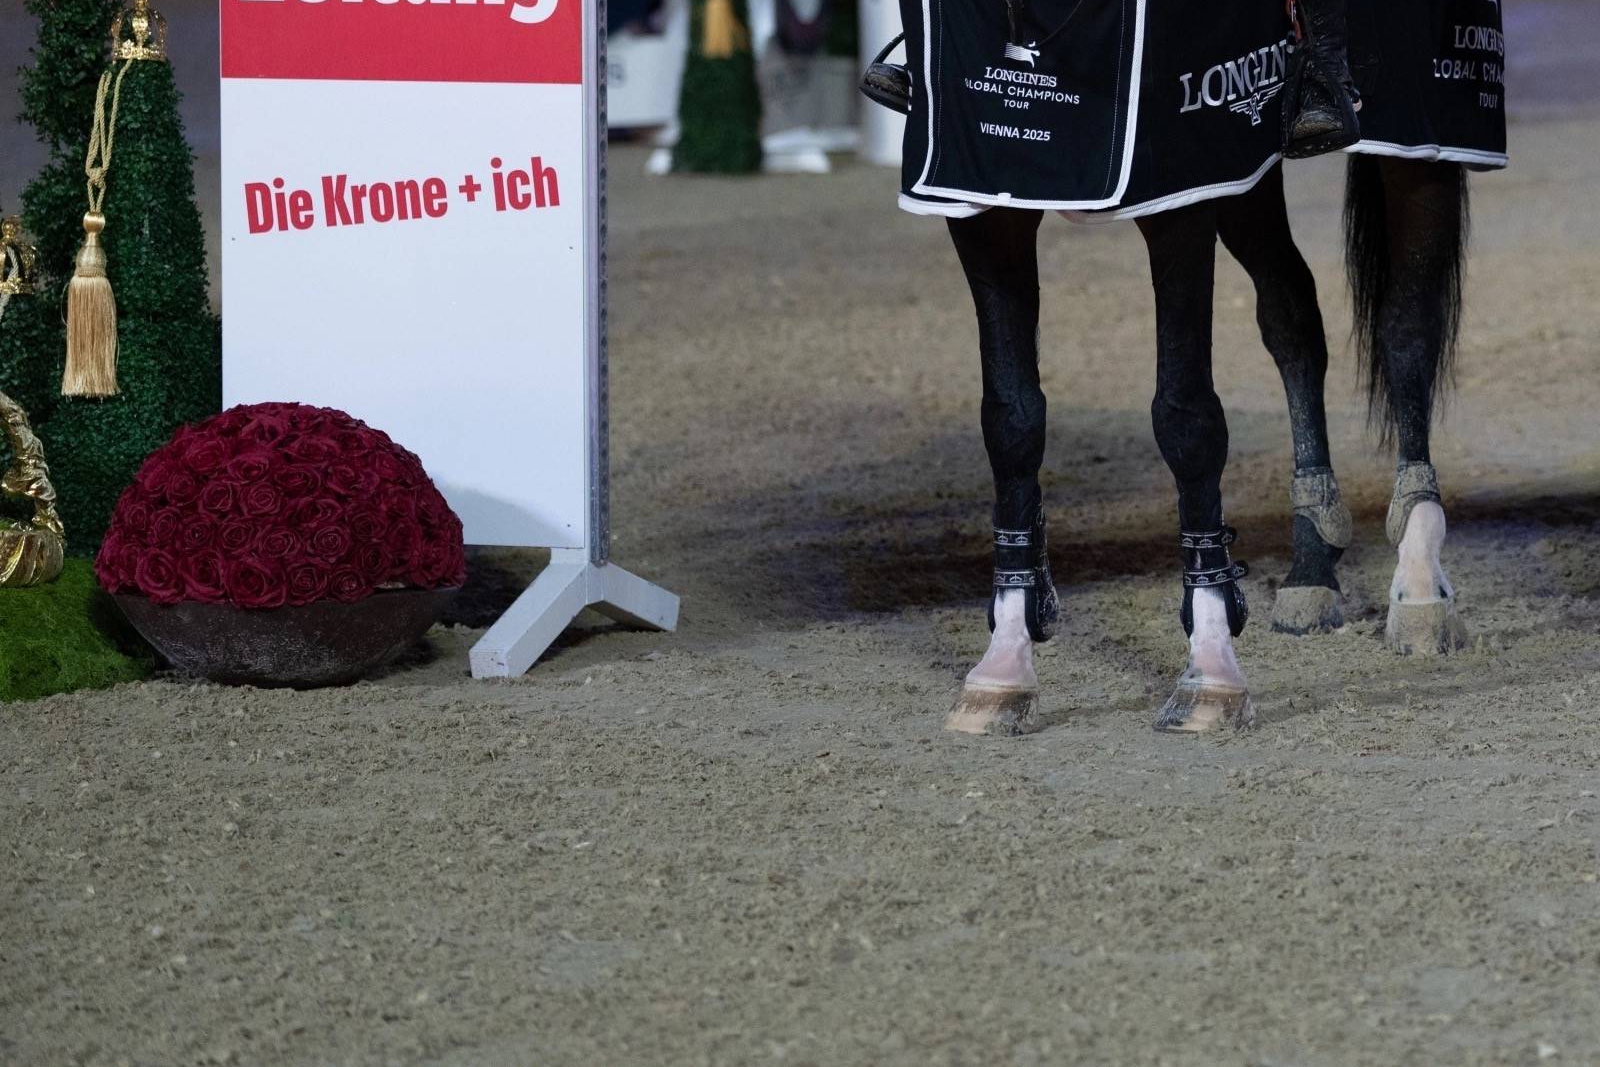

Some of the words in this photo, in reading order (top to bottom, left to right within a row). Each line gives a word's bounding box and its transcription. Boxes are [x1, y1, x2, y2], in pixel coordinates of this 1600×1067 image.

[1454, 25, 1504, 56] LONGI
[984, 66, 1057, 88] LONGINES
[1180, 38, 1295, 113] LONGIN
[1433, 58, 1477, 80] LOBAL
[1003, 99, 1030, 109] TOUR
[1007, 86, 1080, 105] CHAMPIONS
[980, 121, 1020, 139] VIENNA
[1022, 128, 1051, 141] 2025
[245, 177, 314, 234] Die
[321, 174, 448, 227] Krone
[459, 175, 482, 202] +
[490, 156, 560, 211] ich
